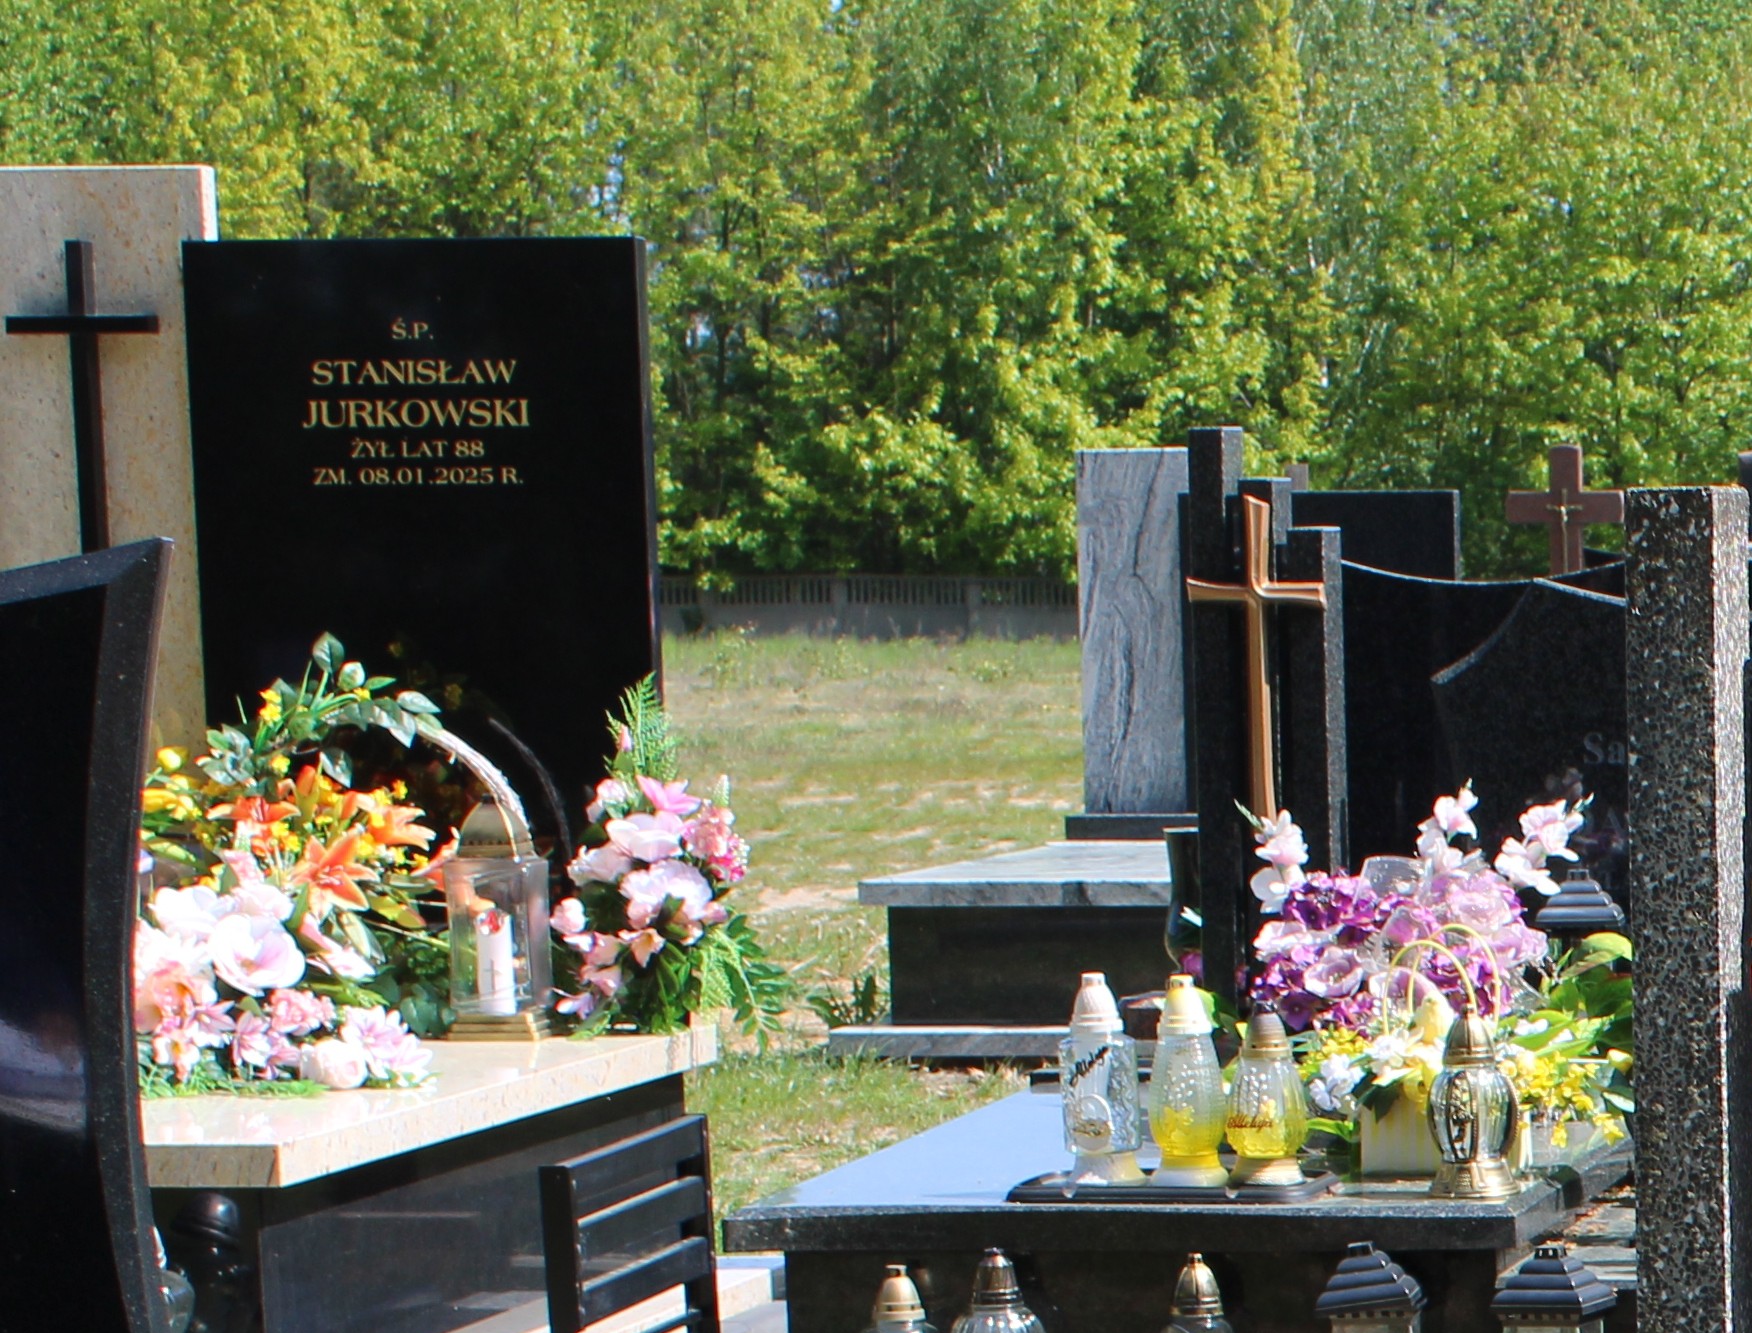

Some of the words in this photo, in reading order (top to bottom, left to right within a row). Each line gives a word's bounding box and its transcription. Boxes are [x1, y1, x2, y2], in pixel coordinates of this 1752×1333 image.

[311, 359, 517, 385] STANISŁAW
[302, 399, 530, 428] JURKOWSKI
[351, 437, 395, 458] ŻYŁ
[401, 440, 448, 457] LAT
[455, 440, 485, 457] 88
[313, 468, 352, 485] ZM.
[360, 467, 494, 485] 08.01.2025
[502, 467, 524, 485] R.
[1583, 731, 1626, 766] Sa
